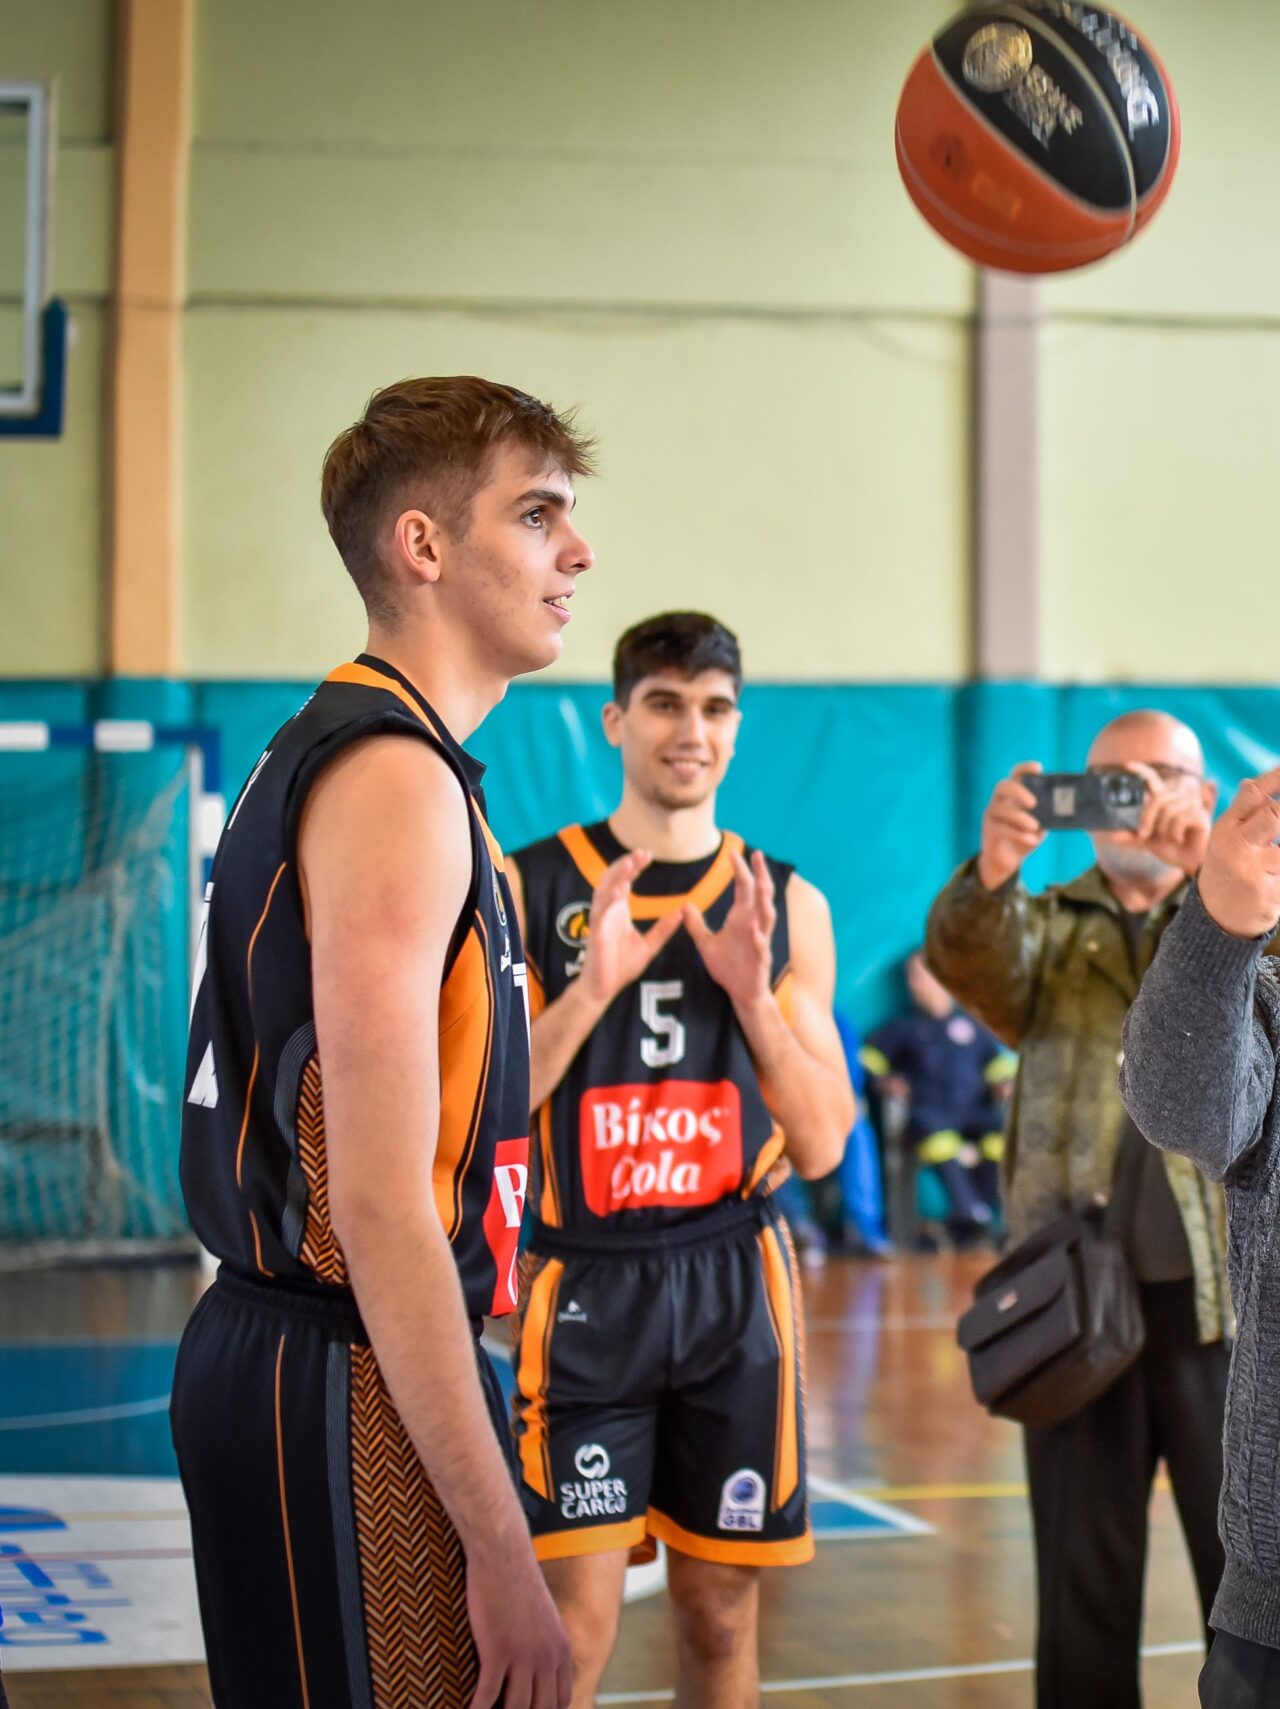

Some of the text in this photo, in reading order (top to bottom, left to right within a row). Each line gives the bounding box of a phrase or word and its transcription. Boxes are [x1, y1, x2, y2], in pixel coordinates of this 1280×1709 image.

[640, 980, 685, 1068] 5
[611, 1150, 702, 1199] Cola
[560, 1479, 628, 1502] SUPER
[561, 1496, 627, 1519] CARGO
